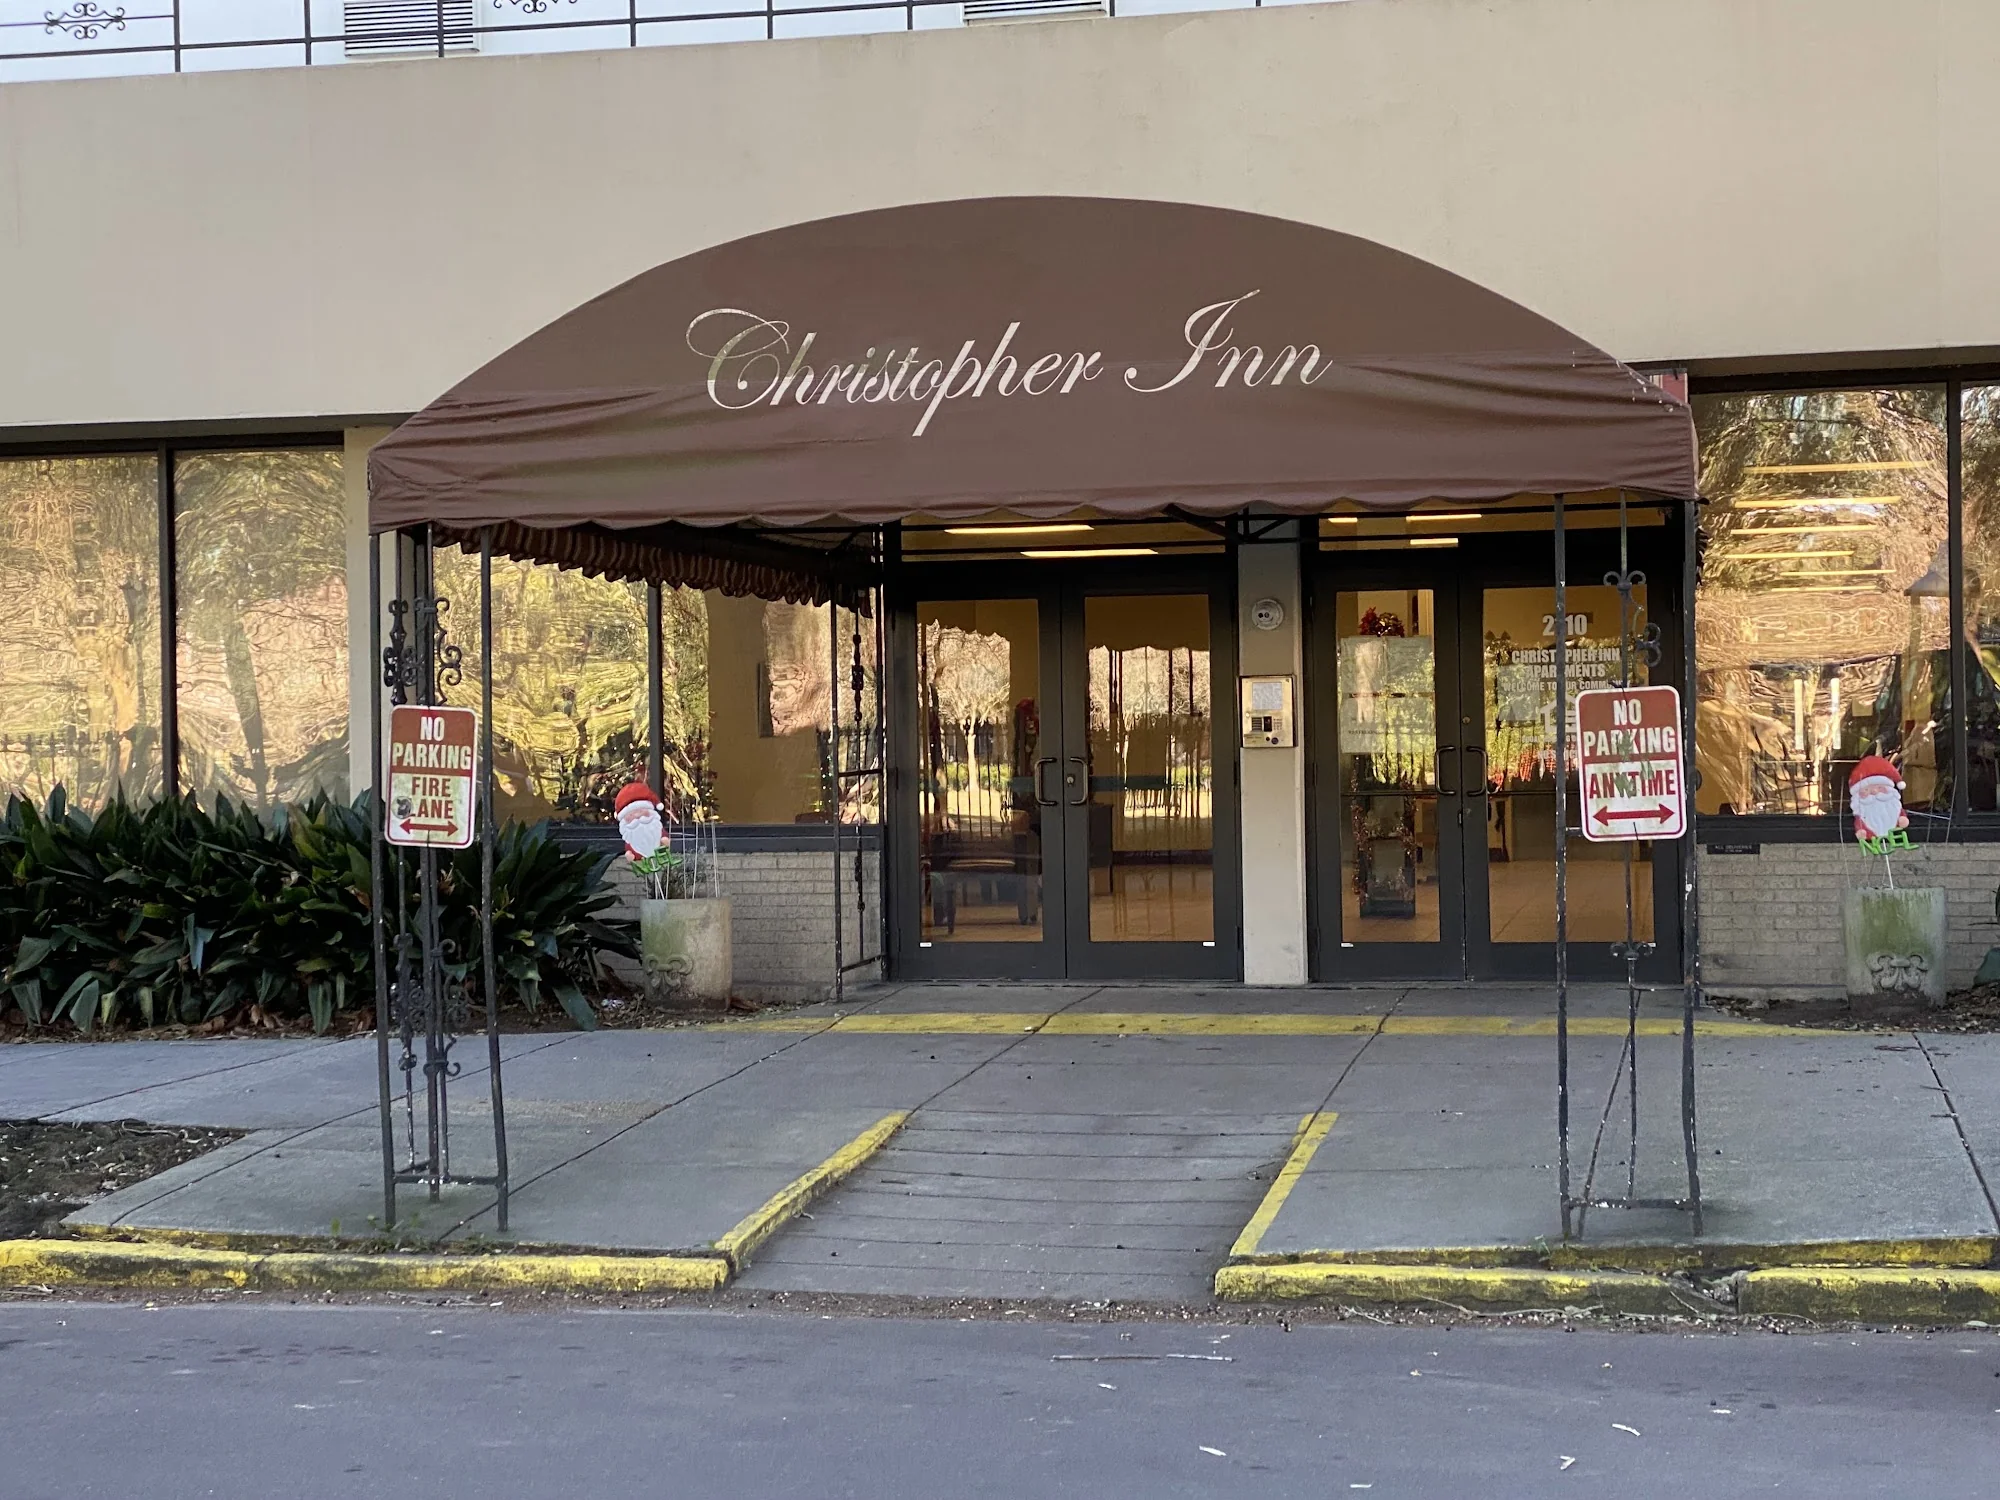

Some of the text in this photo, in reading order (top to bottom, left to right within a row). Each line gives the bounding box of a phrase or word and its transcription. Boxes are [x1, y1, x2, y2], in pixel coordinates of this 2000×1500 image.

[686, 289, 1333, 437] Christopher Inn
[1542, 614, 1588, 636] 210
[1511, 648, 1621, 664] CHRISTPHER INN
[1526, 663, 1607, 679] APARMENTS
[1613, 698, 1642, 726] NO
[420, 716, 445, 742] NO
[1583, 726, 1676, 757] PARKING
[391, 742, 472, 770] PARKING
[411, 776, 451, 797] FIRE
[1589, 769, 1676, 799] ANYTIME
[410, 799, 453, 819] ANE
[1859, 827, 1920, 857] NOEL
[630, 846, 683, 877] NOEL
